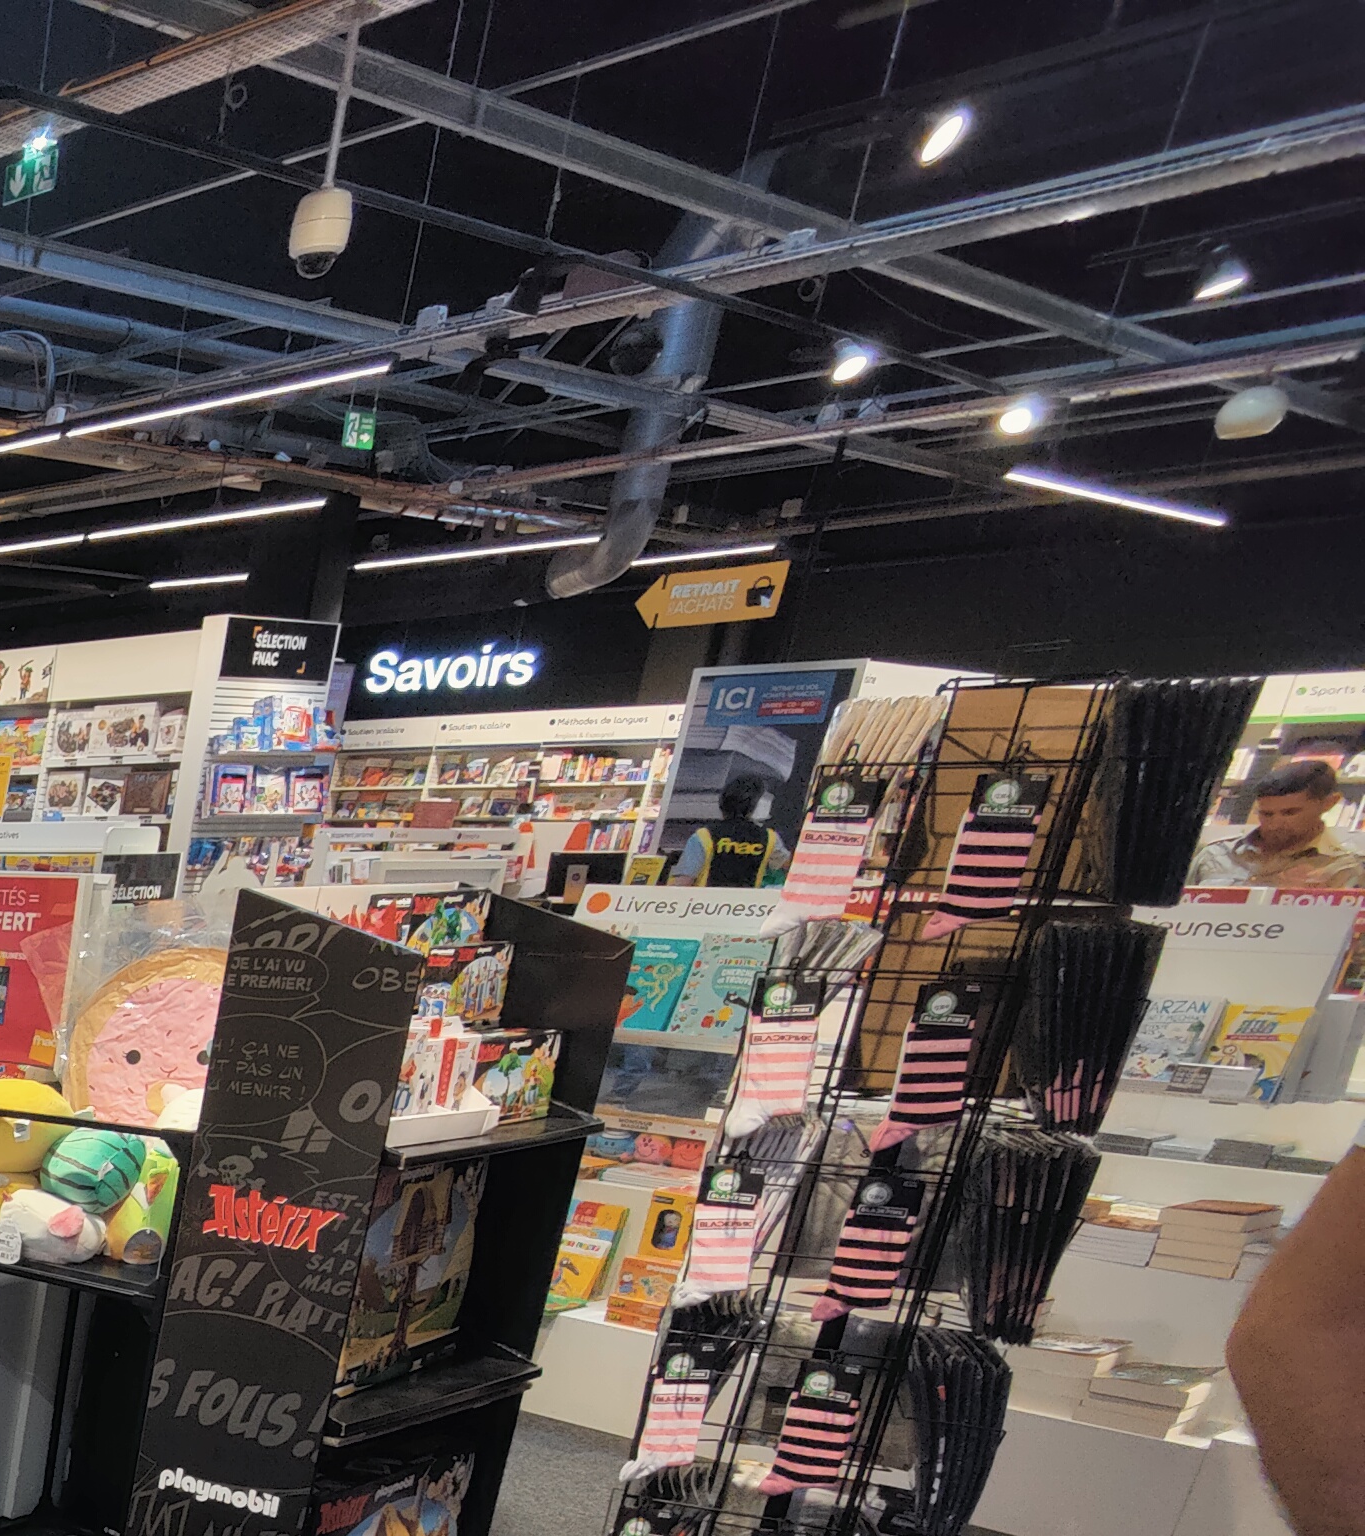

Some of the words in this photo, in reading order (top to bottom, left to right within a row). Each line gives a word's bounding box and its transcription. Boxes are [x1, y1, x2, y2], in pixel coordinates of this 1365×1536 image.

[670, 578, 741, 599] RETRAIT
[254, 631, 306, 652] SÉLECTION
[252, 652, 280, 667] FNAC
[365, 642, 535, 695] Savoirs
[714, 686, 756, 711] ICI
[478, 721, 511, 733] scolaire
[556, 716, 597, 728] Méthodes
[599, 716, 610, 726] de
[612, 715, 649, 728] langues
[716, 836, 765, 857] fnac
[613, 894, 678, 915] Livres
[230, 956, 250, 972] JE
[283, 956, 307, 972] VU
[241, 1040, 273, 1060] ÇA
[276, 1044, 300, 1059] NE
[235, 1060, 272, 1077] PAS
[278, 1064, 304, 1081] UN
[202, 1184, 343, 1253] Astérix
[174, 1370, 303, 1448] FOUS
[158, 1468, 280, 1518] playmobil
[374, 1475, 415, 1501] playmobil
